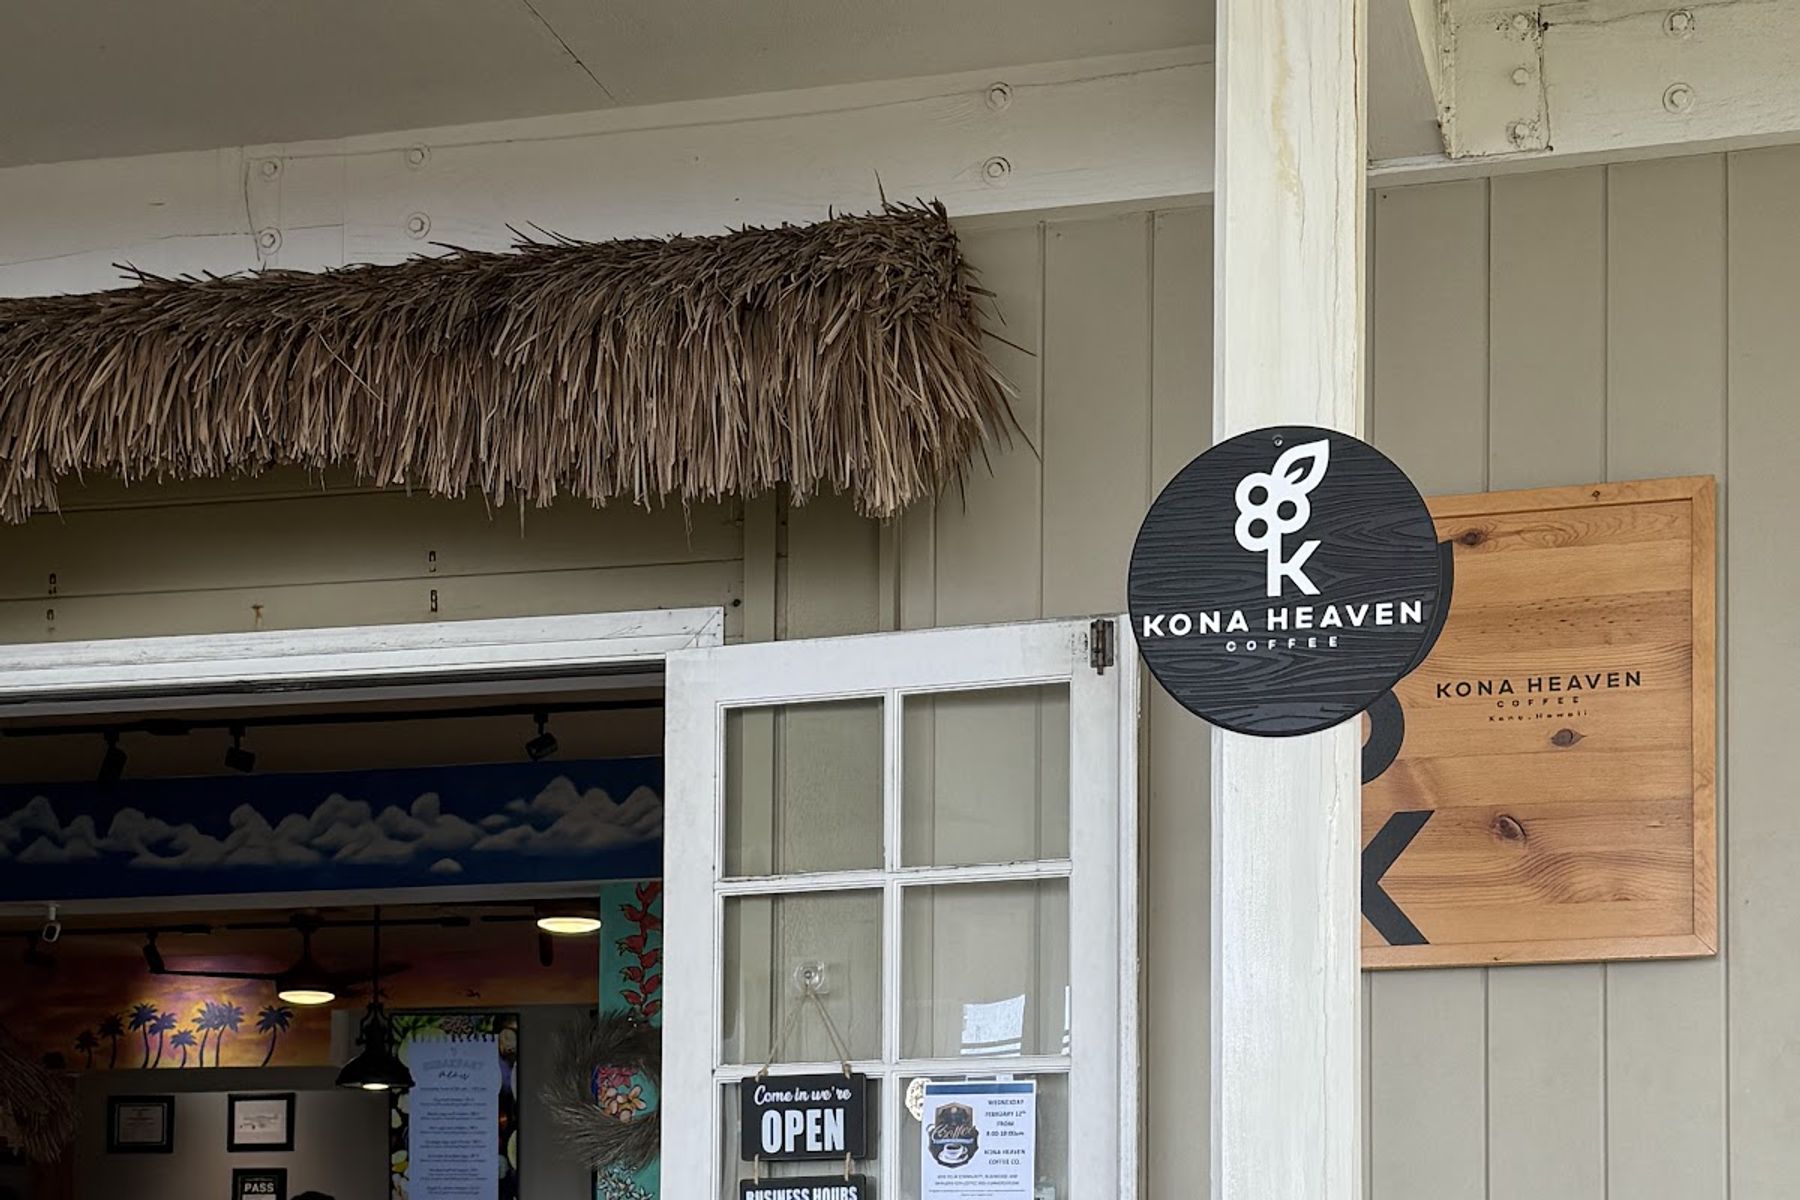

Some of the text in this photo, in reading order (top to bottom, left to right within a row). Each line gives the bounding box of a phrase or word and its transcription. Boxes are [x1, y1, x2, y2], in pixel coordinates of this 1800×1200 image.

[1143, 600, 1423, 638] KONA HEAVEN
[1225, 635, 1338, 652] COFFEE
[1436, 670, 1641, 699] KONA HEAVEN
[1496, 695, 1579, 709] COFFEE
[754, 1085, 852, 1106] Come in we're
[761, 1107, 845, 1154] OPEN
[244, 1182, 274, 1193] PASS
